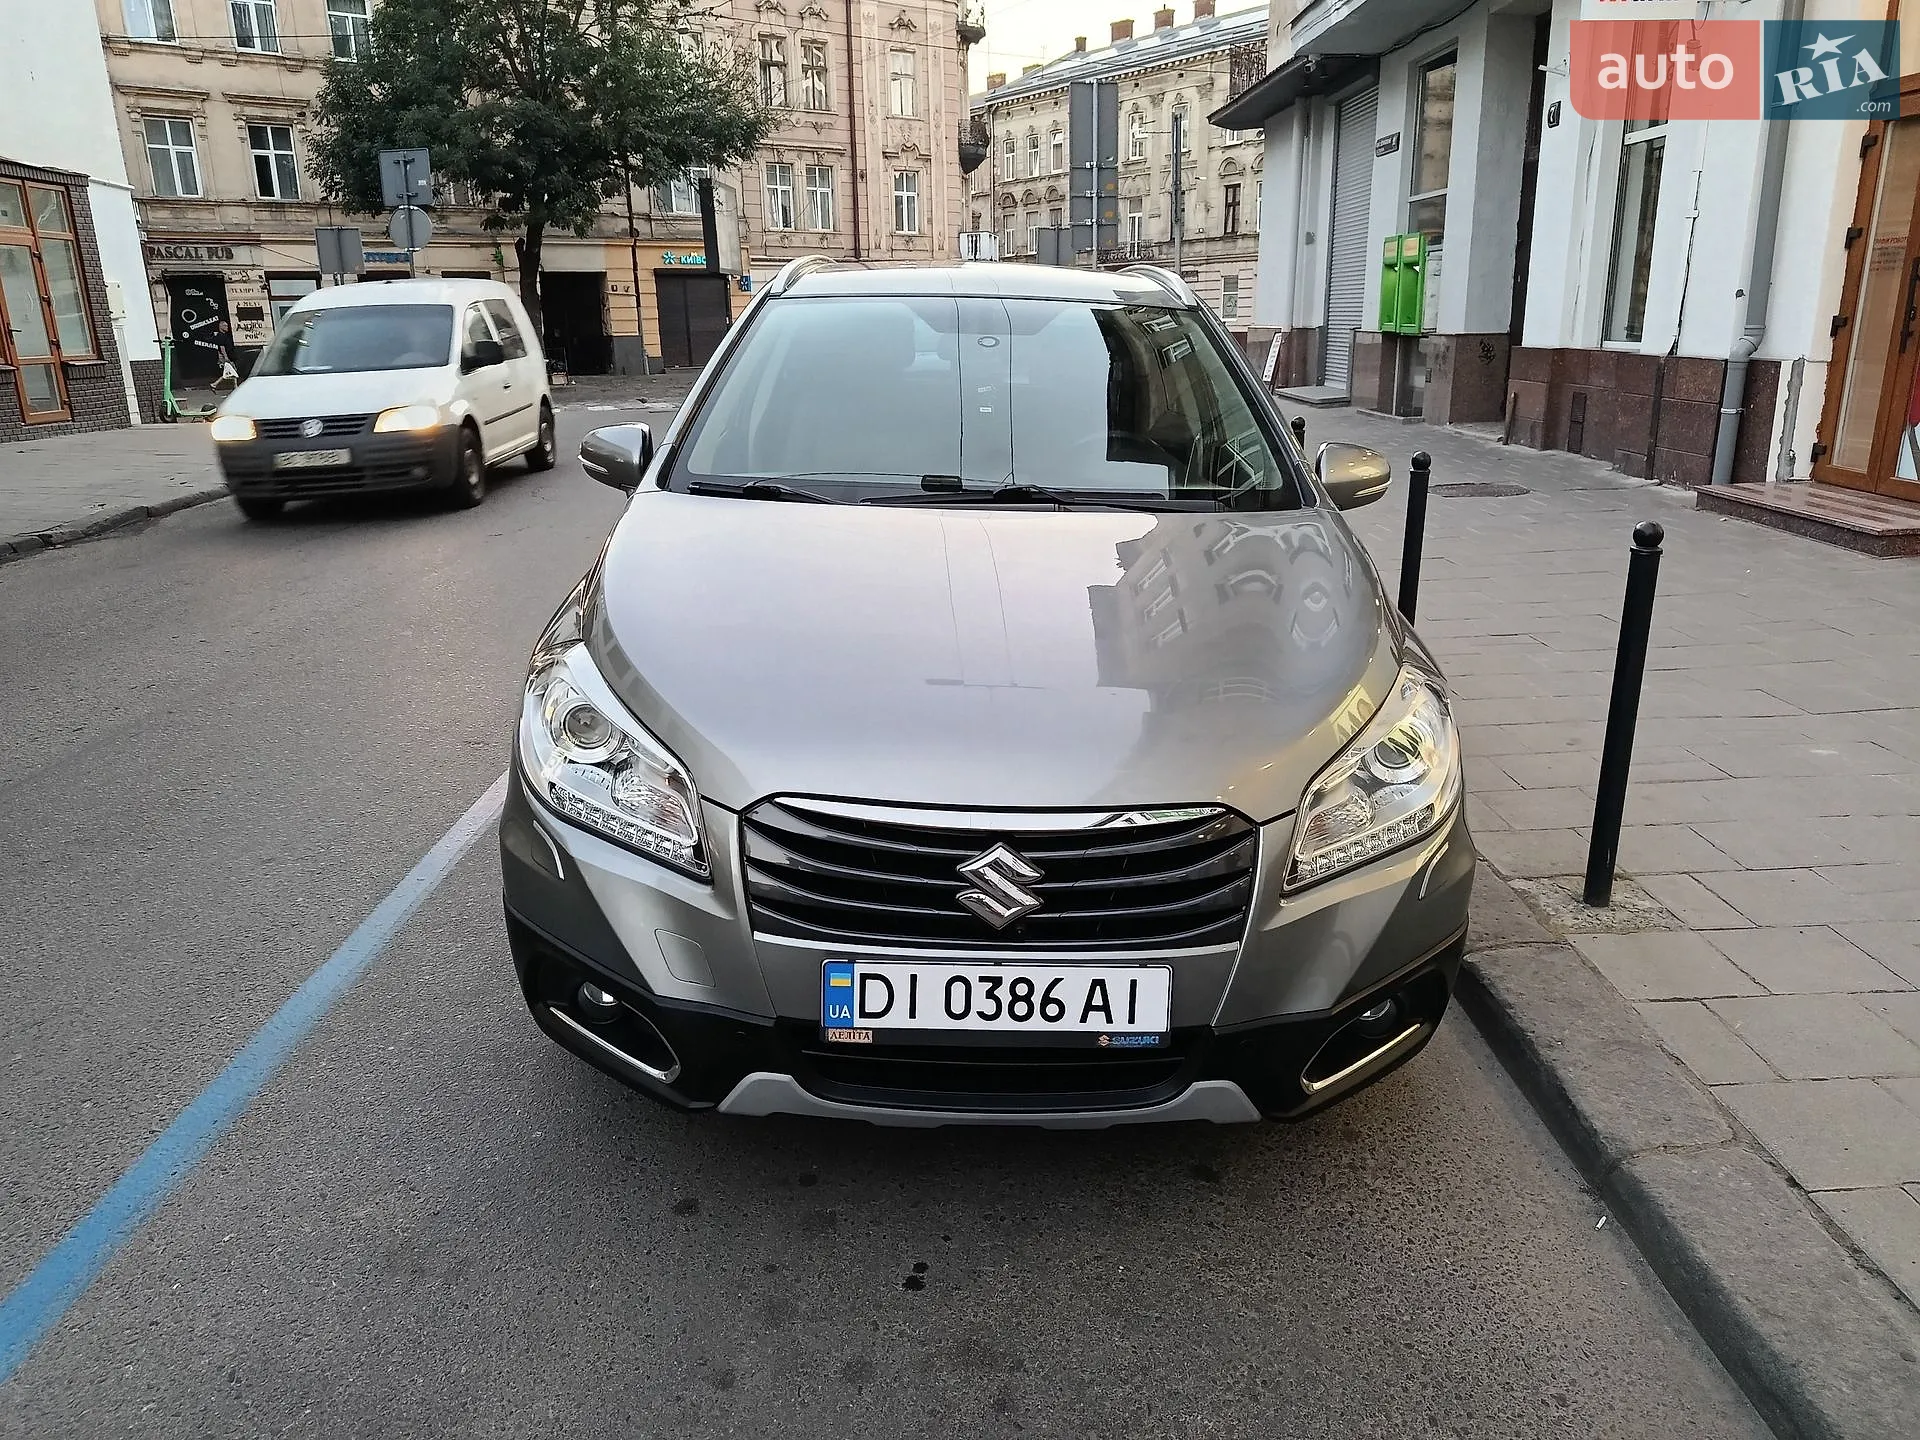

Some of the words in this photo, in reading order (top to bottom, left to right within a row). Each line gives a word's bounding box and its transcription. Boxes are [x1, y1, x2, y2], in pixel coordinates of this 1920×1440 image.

[147, 245, 204, 259] PASCAL
[206, 246, 234, 259] PUB
[858, 972, 917, 1020] DI
[943, 974, 1066, 1023] 0386
[1078, 978, 1138, 1025] AI
[829, 1004, 851, 1019] UA
